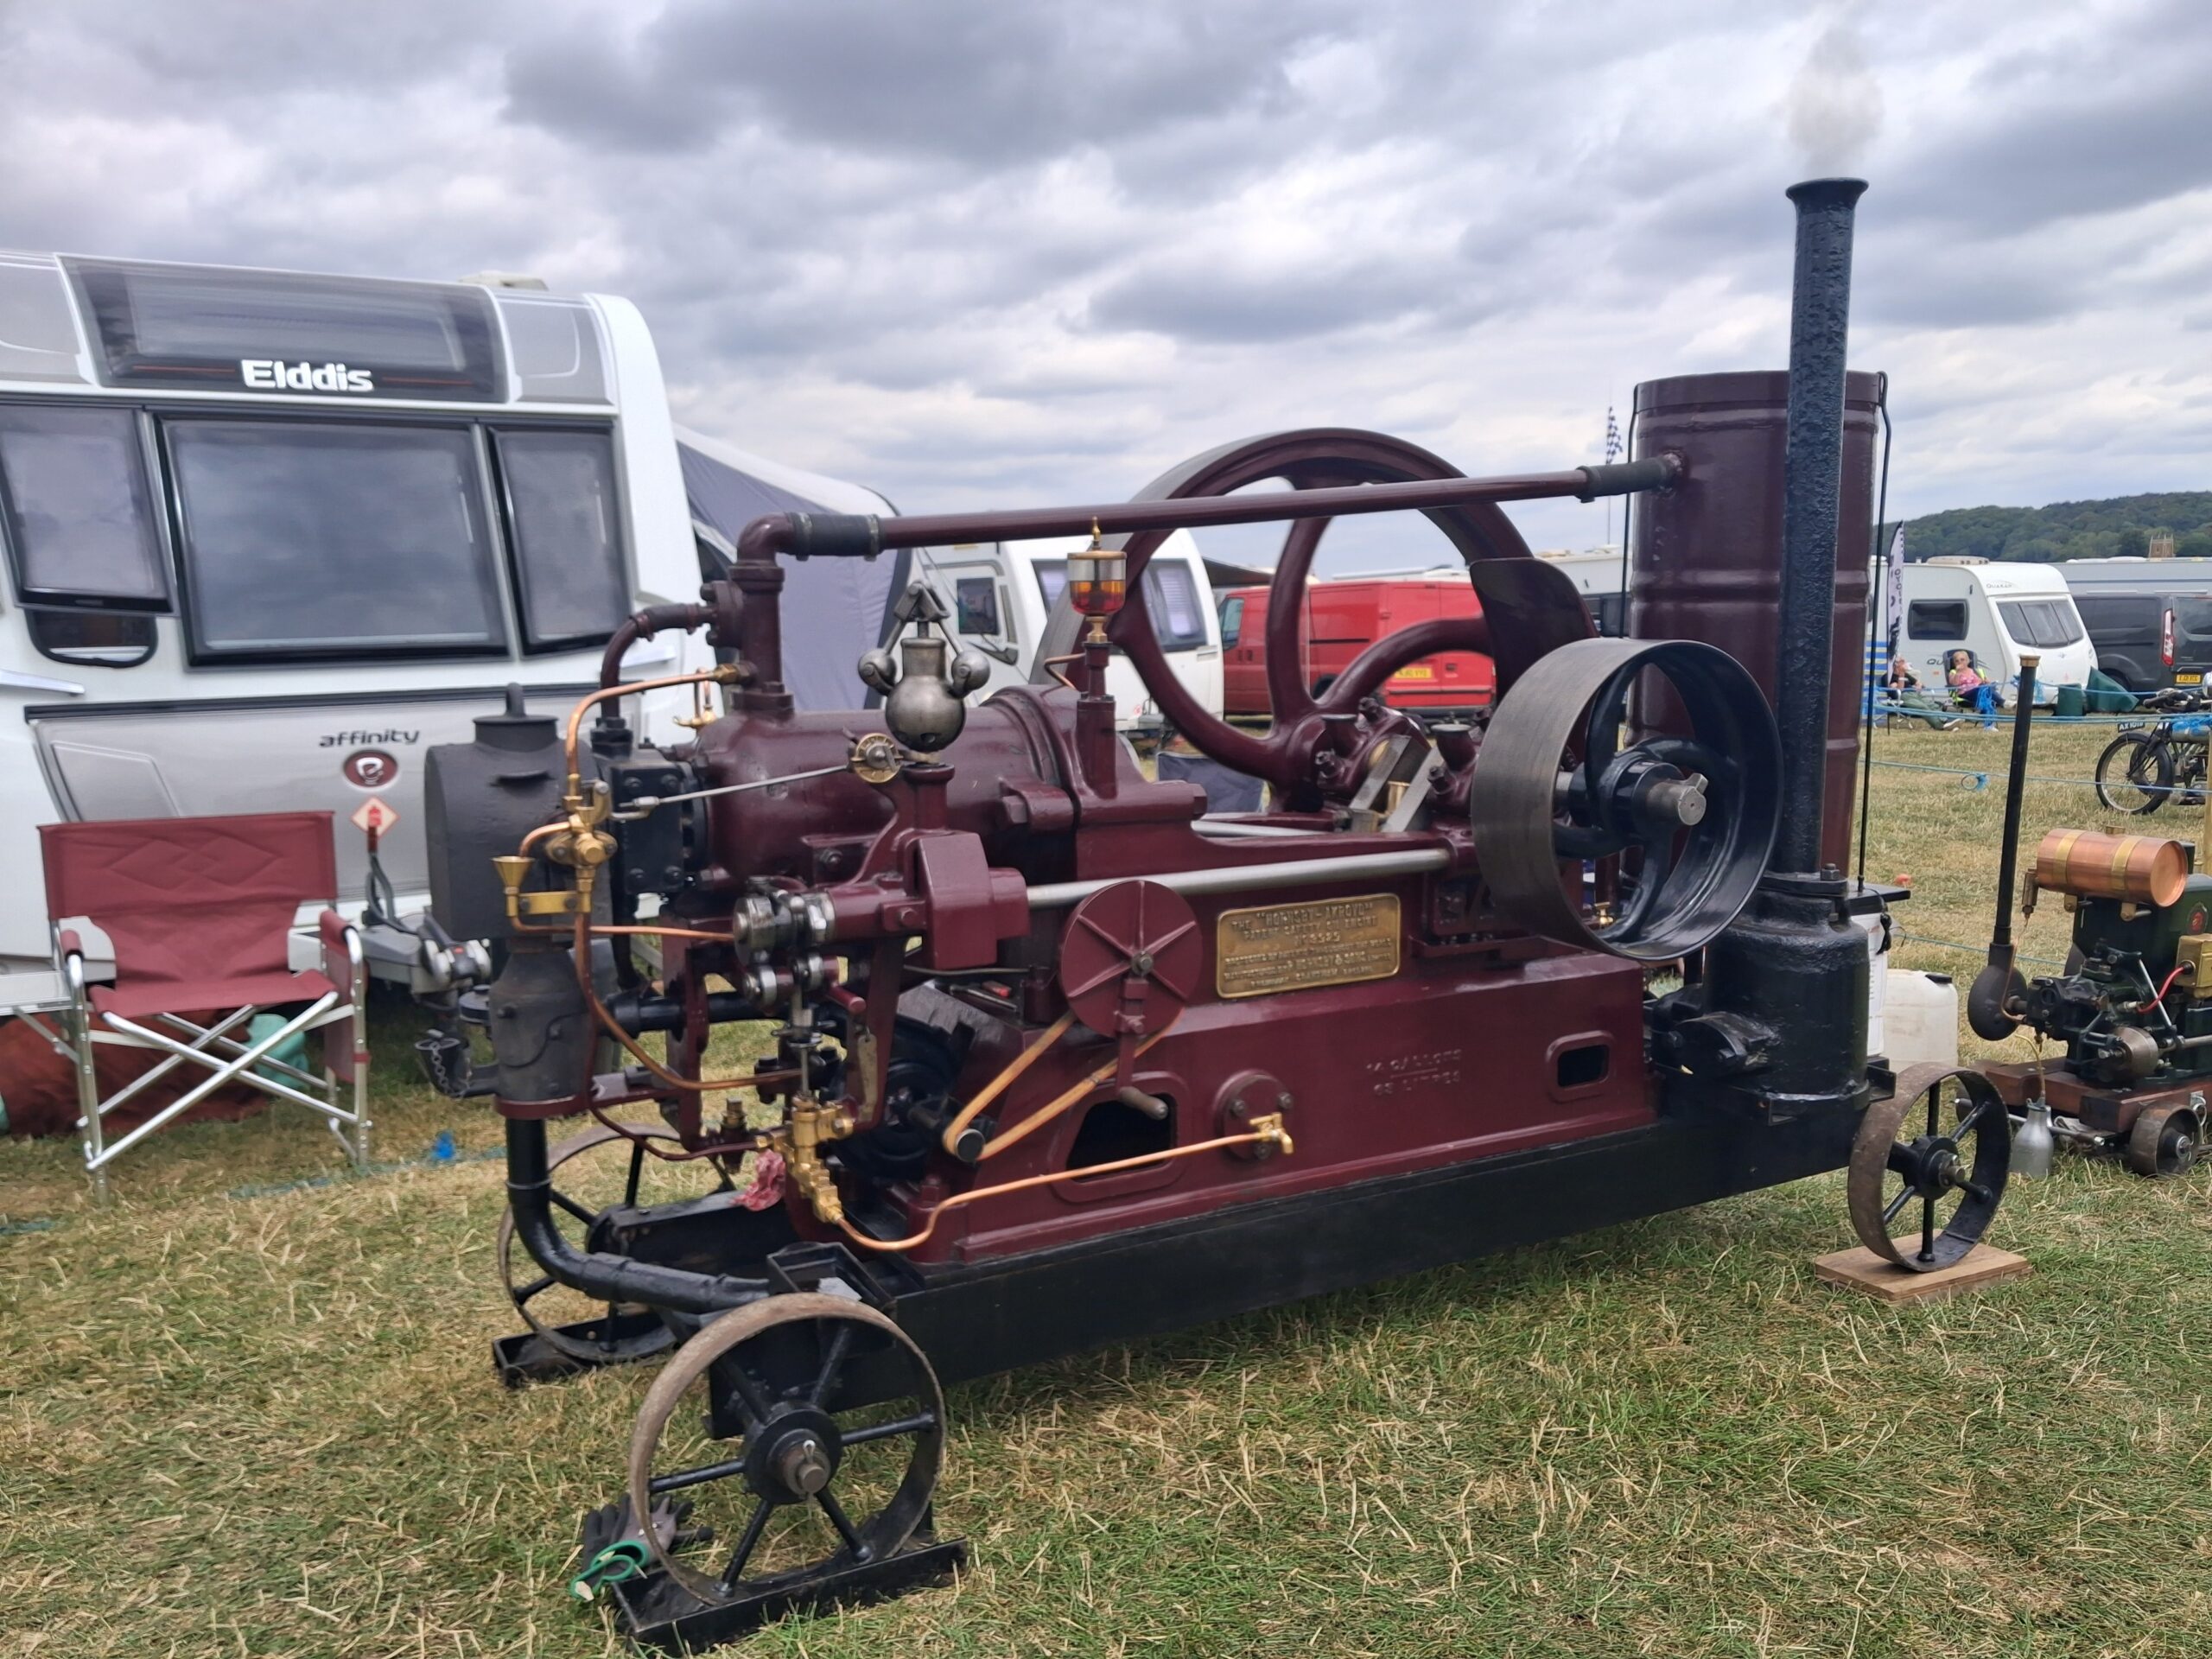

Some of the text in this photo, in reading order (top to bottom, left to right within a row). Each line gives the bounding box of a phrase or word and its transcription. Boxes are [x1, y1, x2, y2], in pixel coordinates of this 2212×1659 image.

[242, 359, 374, 391] Elddis
[320, 729, 420, 747] affinity
[1231, 919, 1251, 931] THE
